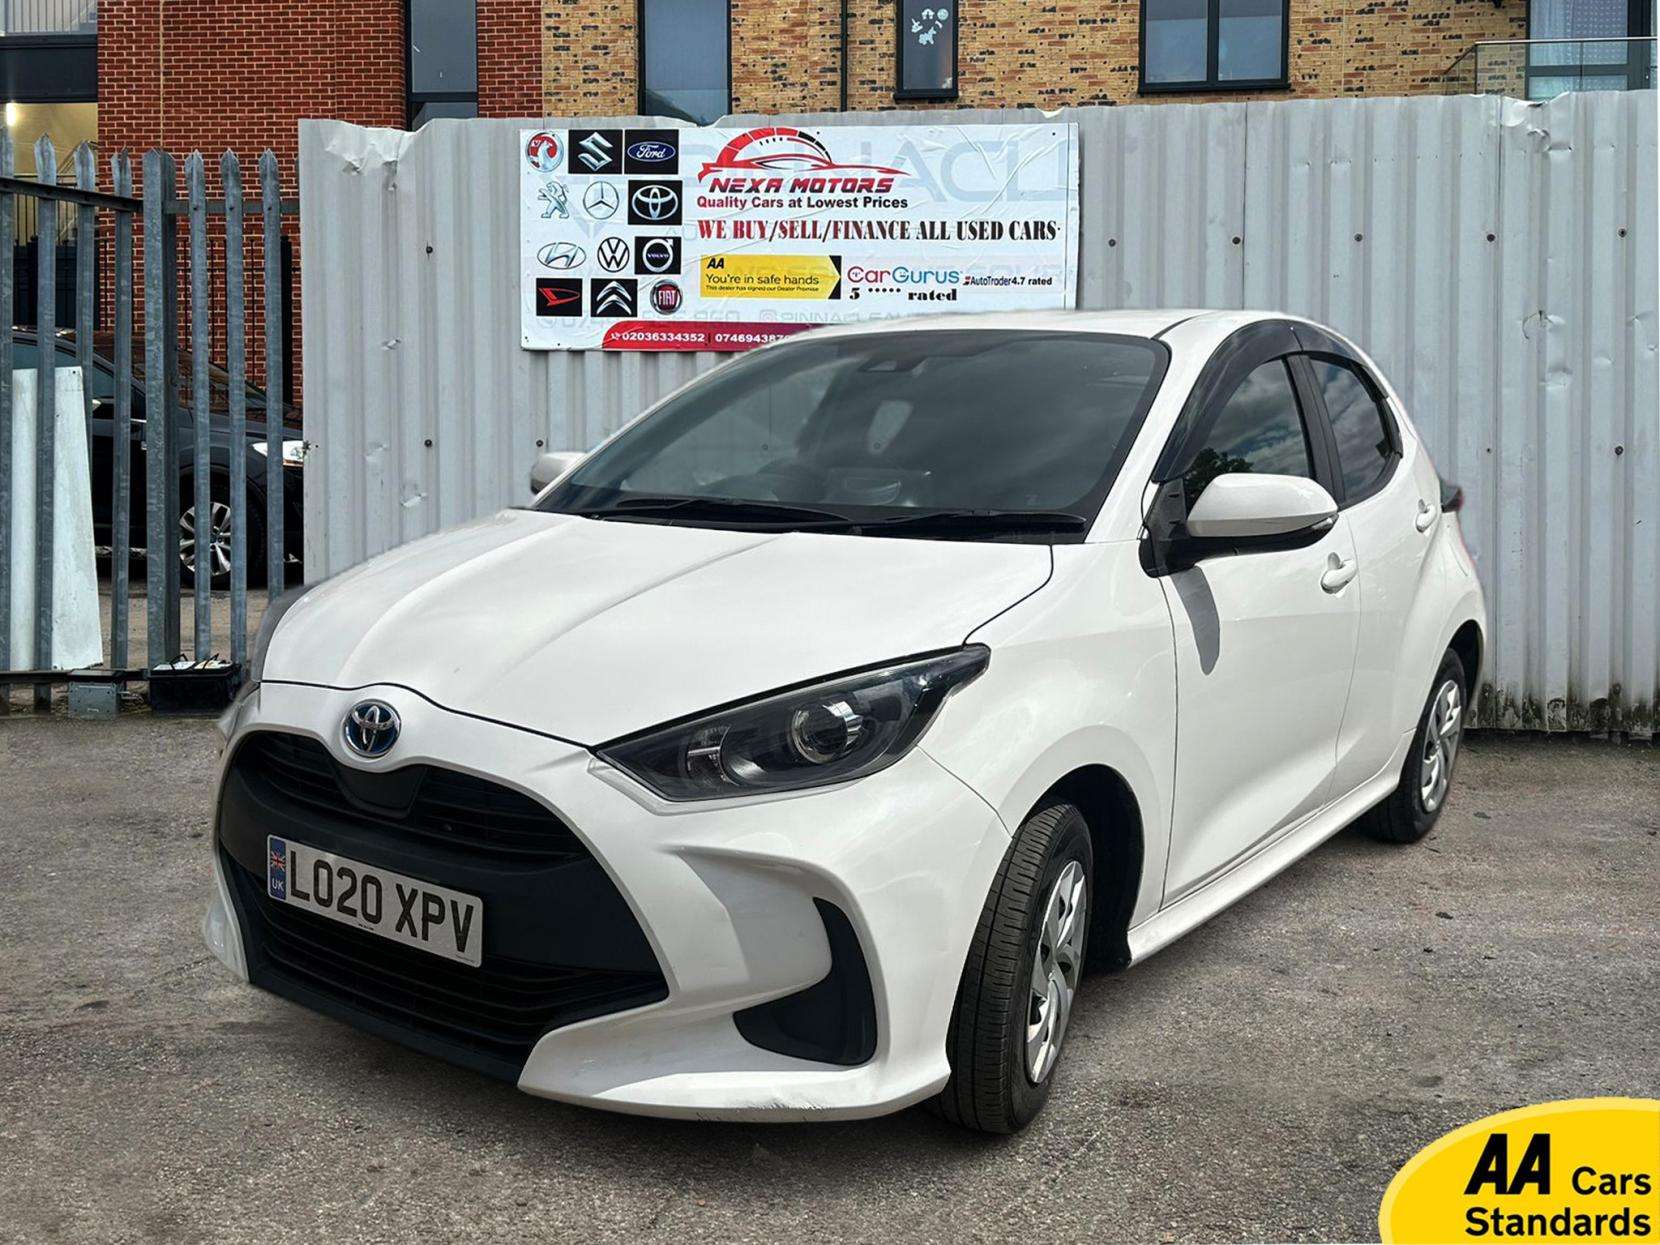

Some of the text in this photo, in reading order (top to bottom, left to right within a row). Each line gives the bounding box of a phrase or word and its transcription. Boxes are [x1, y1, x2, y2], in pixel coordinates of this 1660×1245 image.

[636, 144, 666, 159] Ford
[709, 178, 895, 193] NEXA MOTORS
[697, 196, 909, 210] Quality Cars at Lowest Prices
[697, 220, 726, 240] WE
[916, 221, 950, 240] ALL
[956, 220, 1004, 241] USED
[1009, 220, 1057, 241] CARS
[706, 257, 725, 269] AA
[705, 274, 819, 284] You're in safe hands
[847, 266, 960, 284] CarGurus
[1028, 276, 1053, 286] rated
[658, 290, 676, 305] FIAT
[849, 287, 957, 301] 5 rated
[622, 332, 705, 342] 02036334352
[272, 879, 284, 891] UK
[290, 850, 474, 953] LO20 XPV
